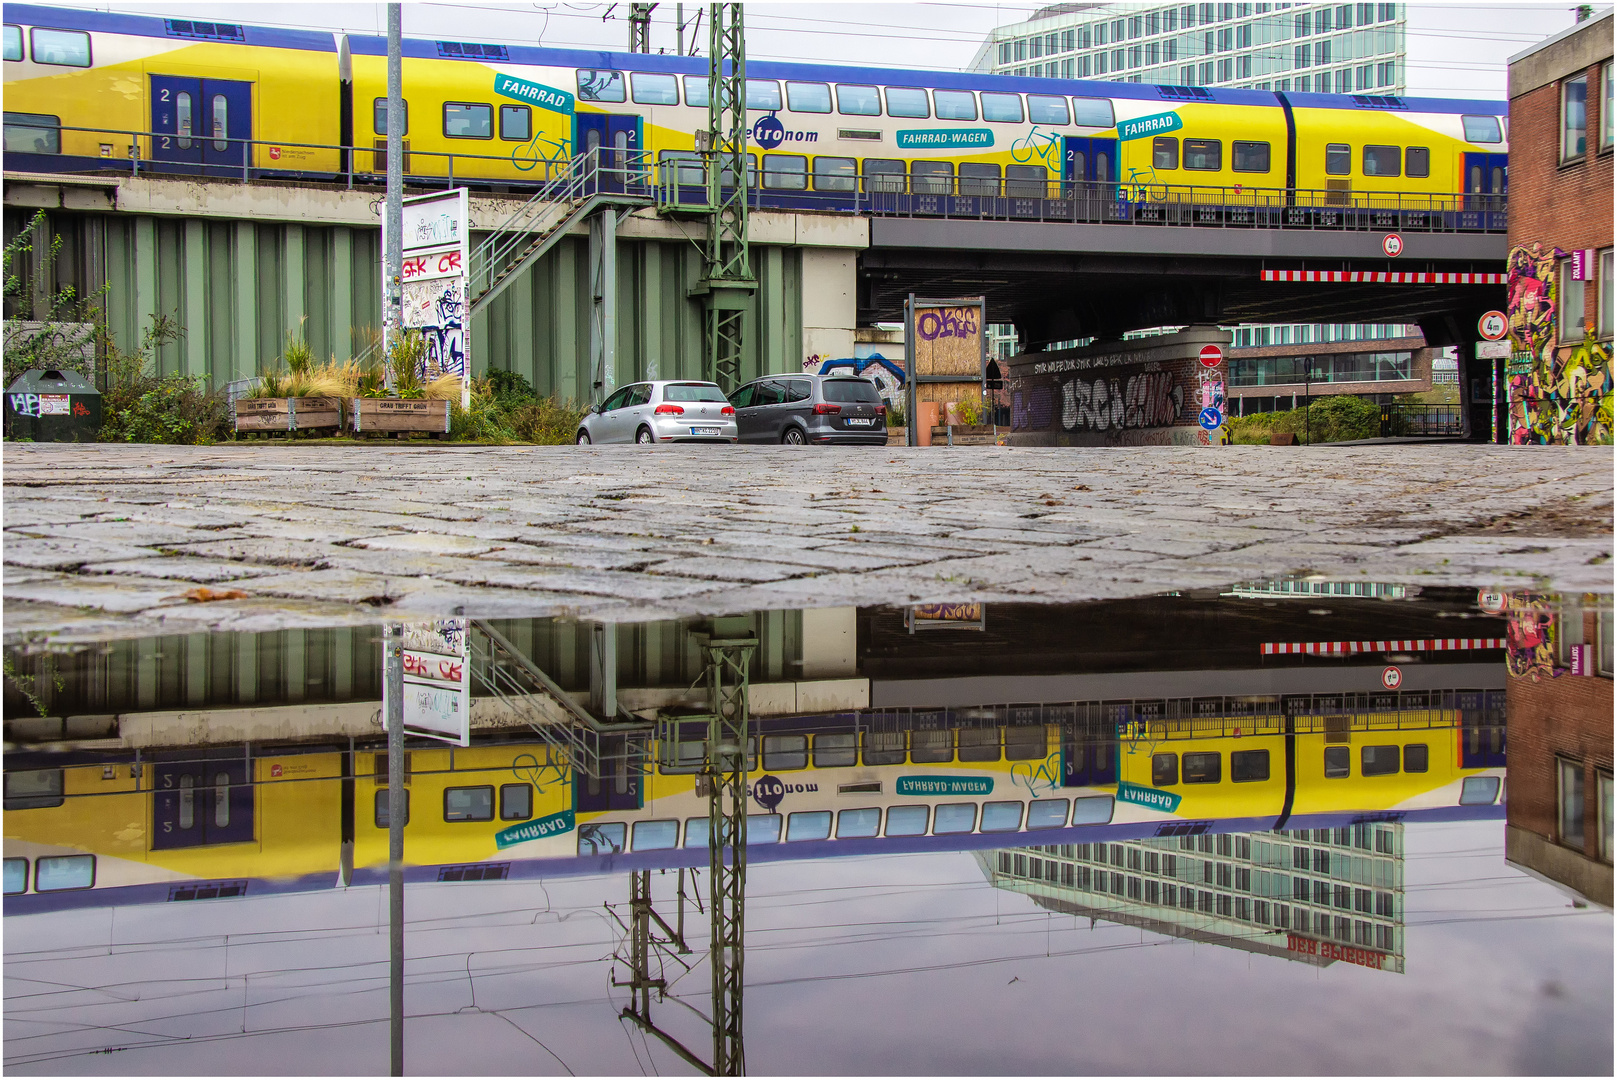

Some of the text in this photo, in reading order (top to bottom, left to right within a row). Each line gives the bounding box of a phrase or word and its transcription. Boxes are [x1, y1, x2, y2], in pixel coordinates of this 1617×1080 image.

[160, 88, 170, 102] 2
[502, 79, 566, 107] FAHRRAD
[1124, 115, 1174, 137] FAHRRAD
[628, 129, 636, 142] 2
[902, 132, 988, 144] FAHRRAD-WAGEN
[161, 136, 171, 150] 2
[1066, 150, 1074, 161] 2
[1572, 251, 1581, 280] ZOLLAMT
[1486, 319, 1500, 331] 4m
